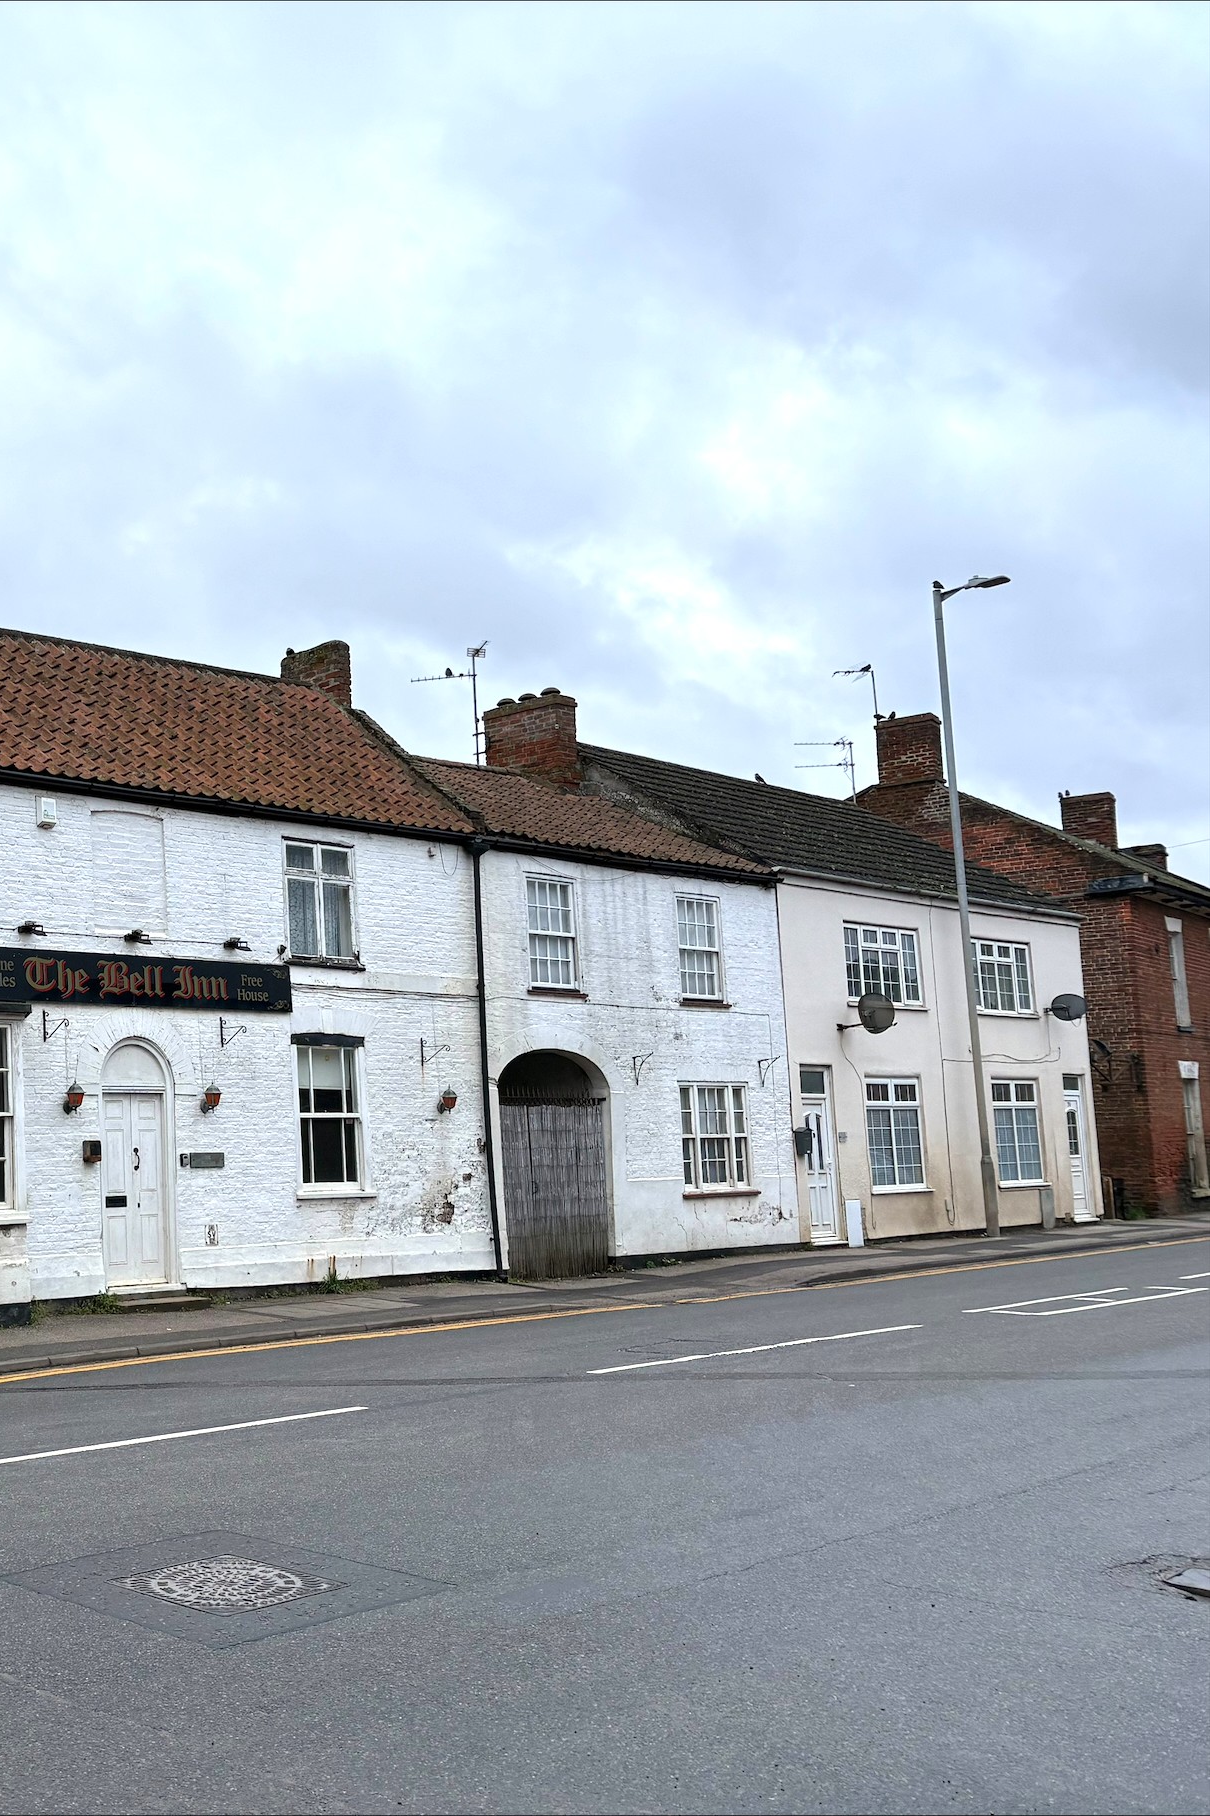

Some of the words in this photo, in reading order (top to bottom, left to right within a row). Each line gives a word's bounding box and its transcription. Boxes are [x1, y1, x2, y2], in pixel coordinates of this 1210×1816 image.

[23, 955, 90, 999] The
[96, 959, 166, 1000] Bell
[171, 964, 230, 1001] Inn
[240, 974, 264, 988] Free
[237, 989, 270, 1002] House
